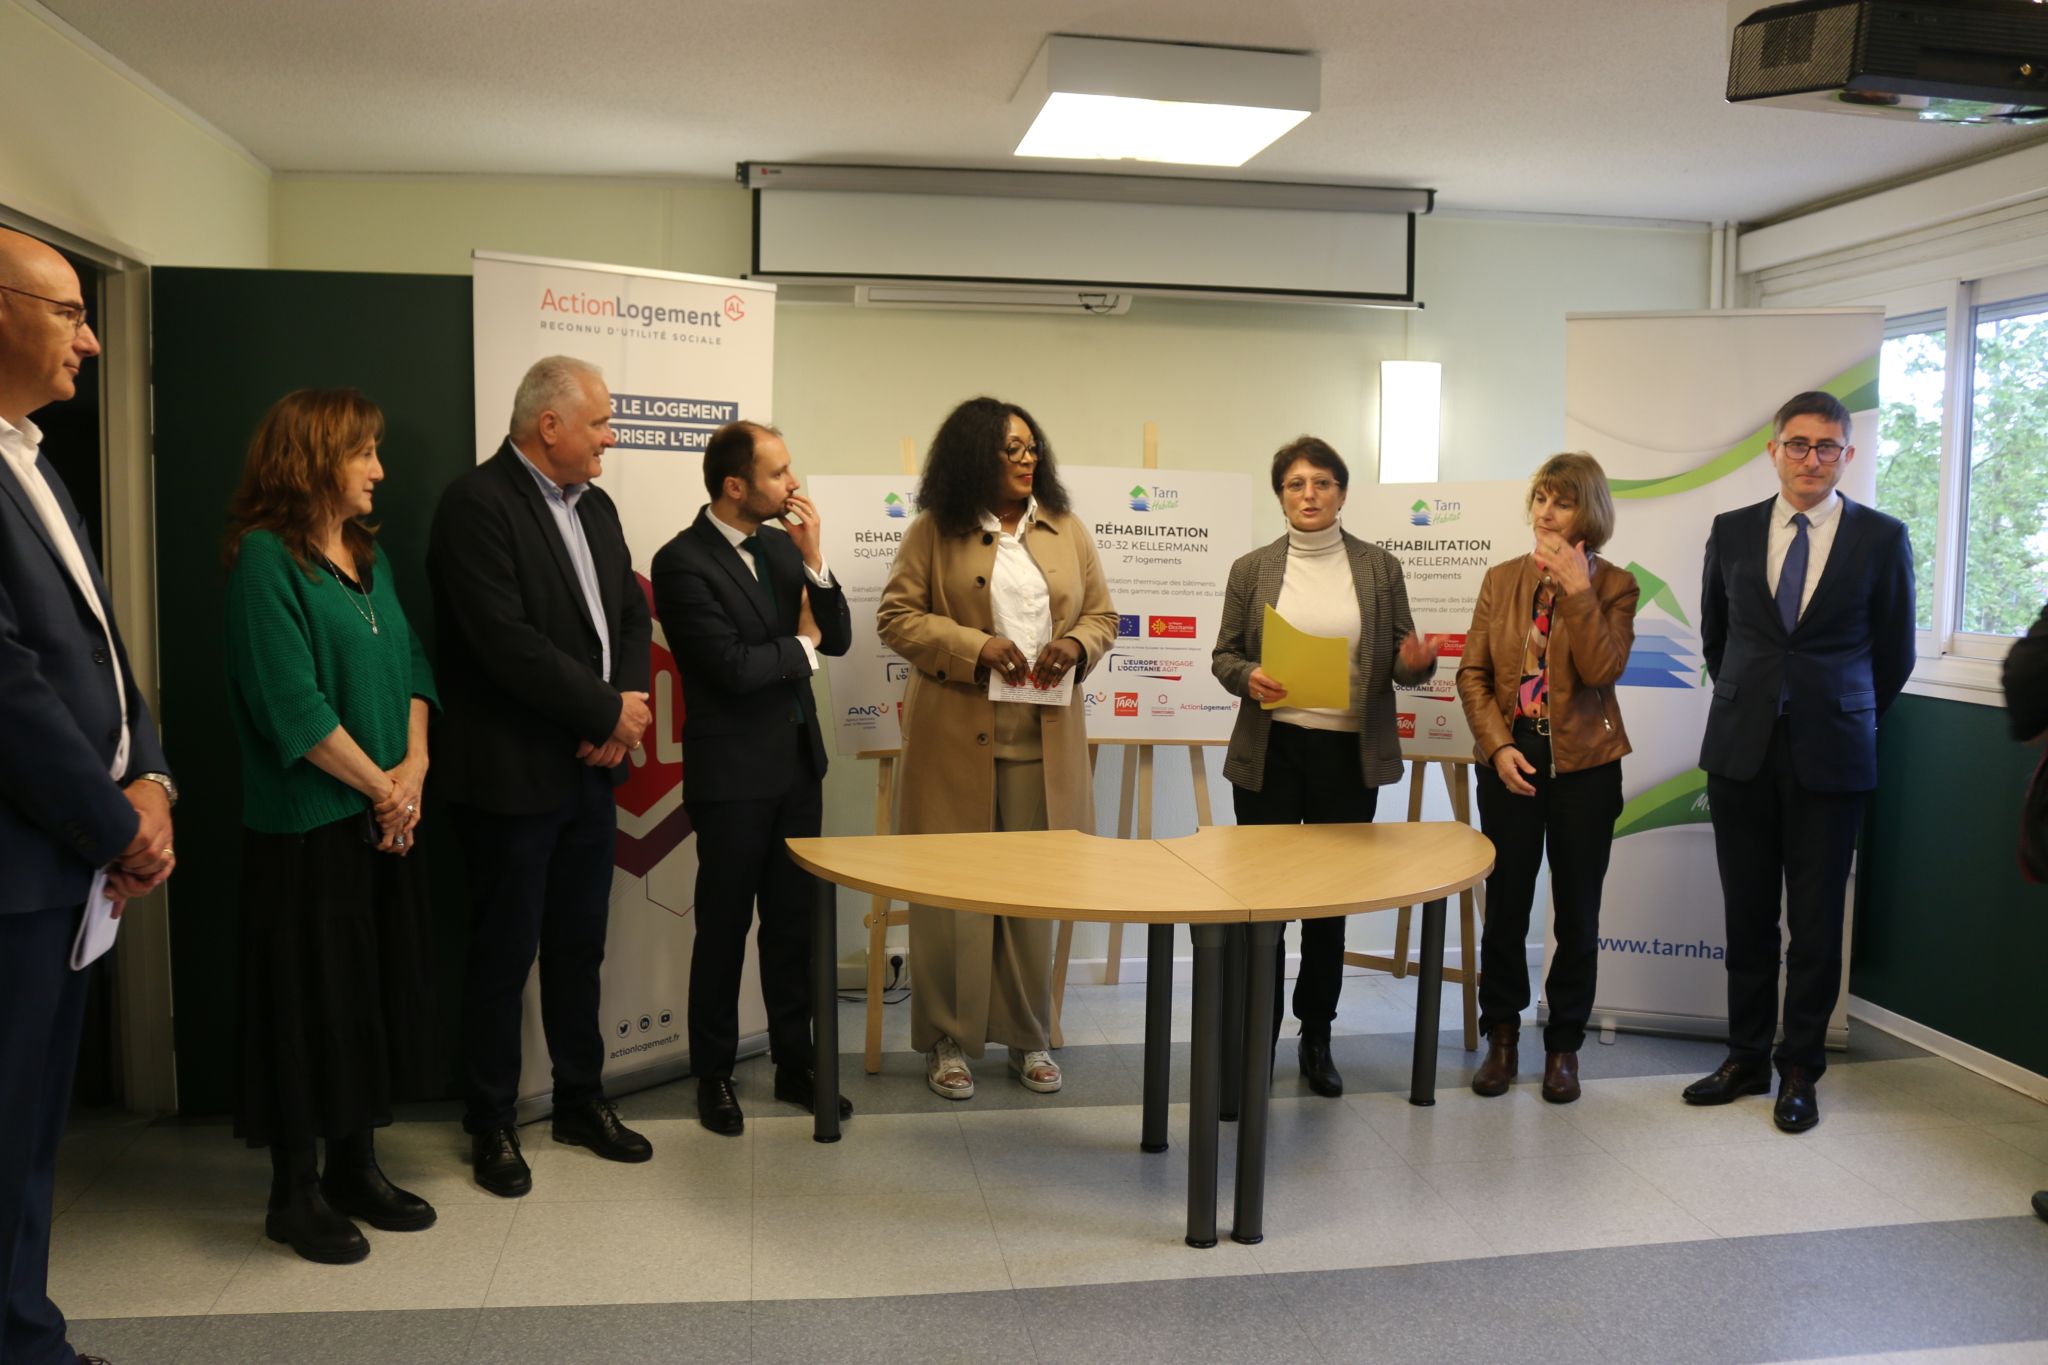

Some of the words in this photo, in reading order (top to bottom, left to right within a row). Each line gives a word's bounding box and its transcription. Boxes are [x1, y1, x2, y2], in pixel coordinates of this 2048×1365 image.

[540, 288, 721, 327] ActionLogement
[541, 320, 600, 334] RECONNU
[607, 326, 666, 340] D'UTILITÉ
[673, 333, 721, 345] SOCIALE
[622, 399, 641, 415] LE
[645, 401, 732, 420] LOGEMENT
[1152, 487, 1178, 498] Tarn
[1152, 500, 1178, 511] Habitat
[1434, 499, 1460, 511] Tarn
[1433, 513, 1461, 524] Habitat
[1095, 522, 1208, 538] RÉHABILITATION
[1097, 540, 1128, 550] 30-32
[1132, 541, 1208, 553] KELLERMANN
[1123, 555, 1132, 563] 27
[1136, 555, 1182, 565] logements
[1408, 557, 1488, 566] KELLERMANN
[1414, 571, 1462, 581] logements
[1115, 696, 1137, 709] TARN
[1180, 703, 1232, 712] ActionLogement
[610, 1033, 680, 1059] actionlogement.fr
